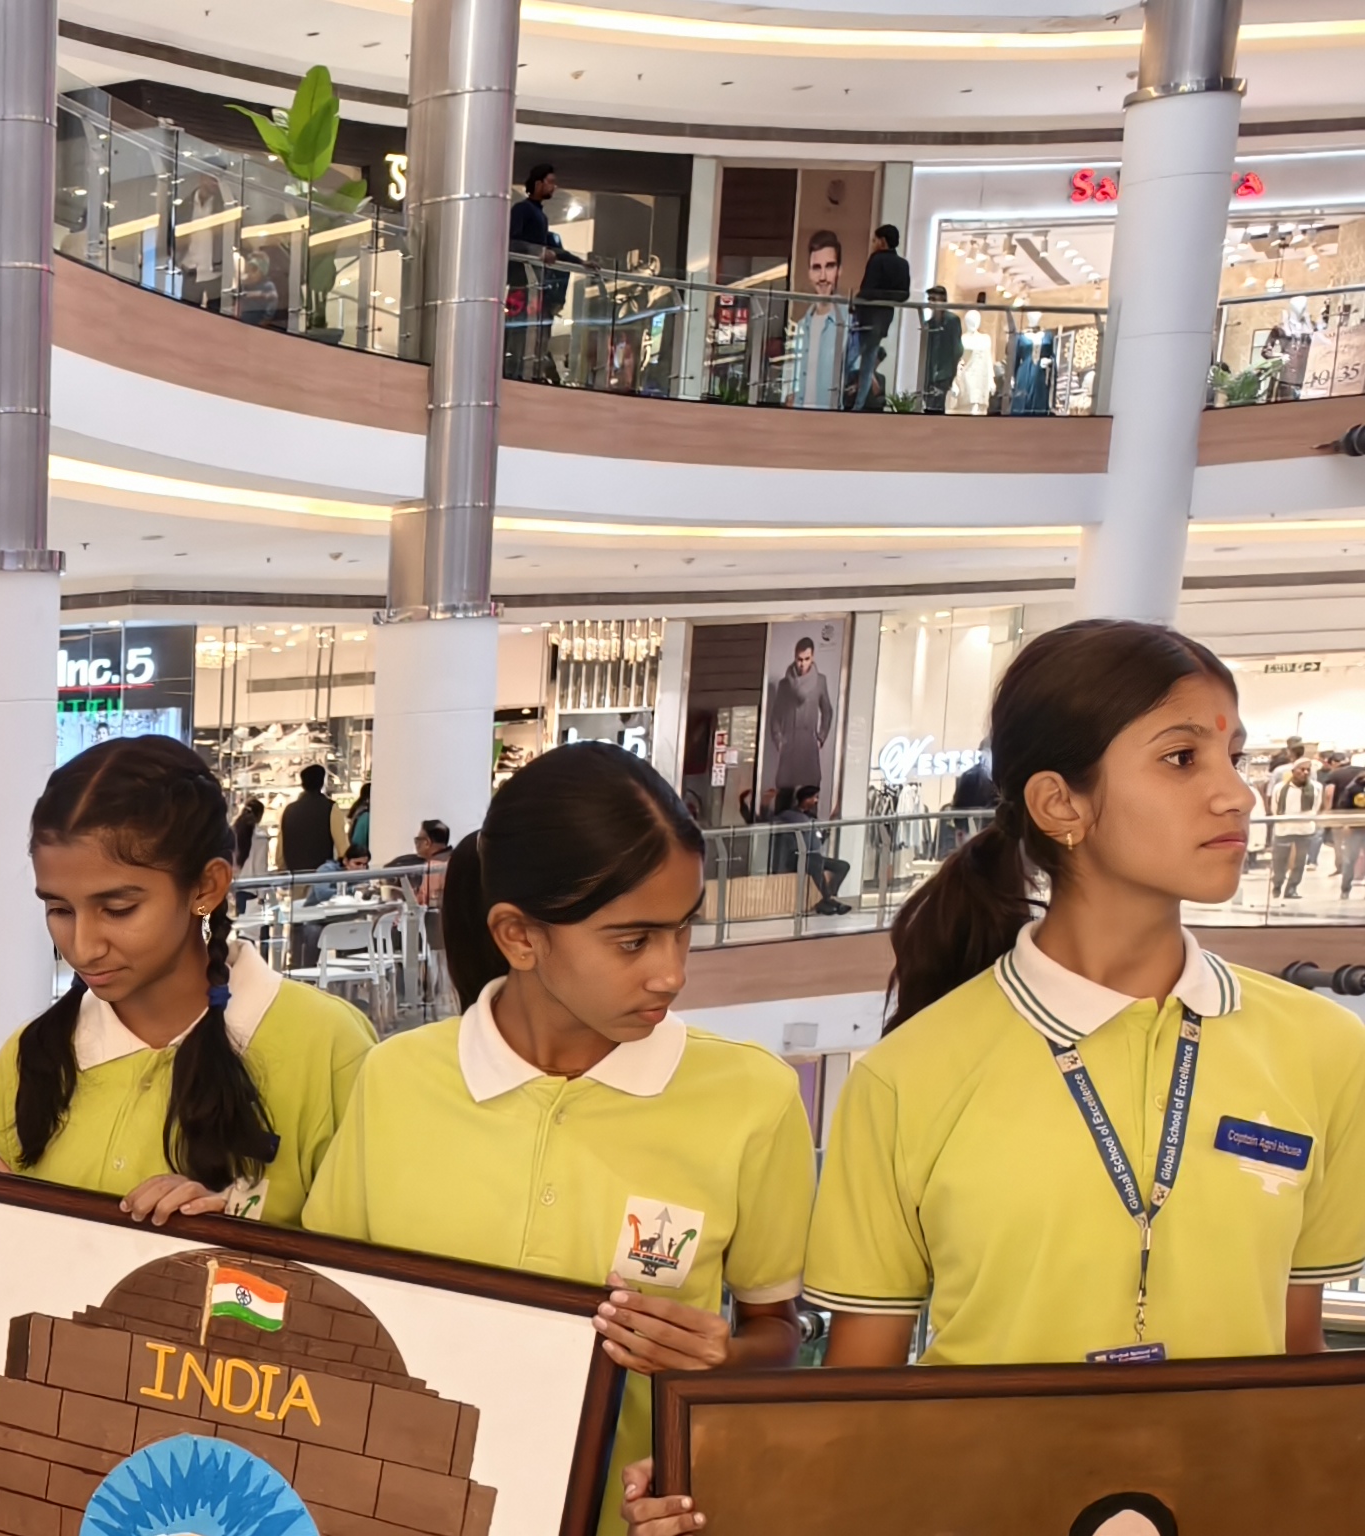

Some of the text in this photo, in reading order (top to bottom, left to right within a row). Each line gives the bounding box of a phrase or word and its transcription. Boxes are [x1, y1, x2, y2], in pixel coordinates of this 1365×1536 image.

[1074, 1073, 1139, 1210] Global School of Excellence
[1160, 1044, 1194, 1181] Global School of Excellence
[1277, 1141, 1302, 1157] House
[140, 1341, 322, 1427] INDIA
